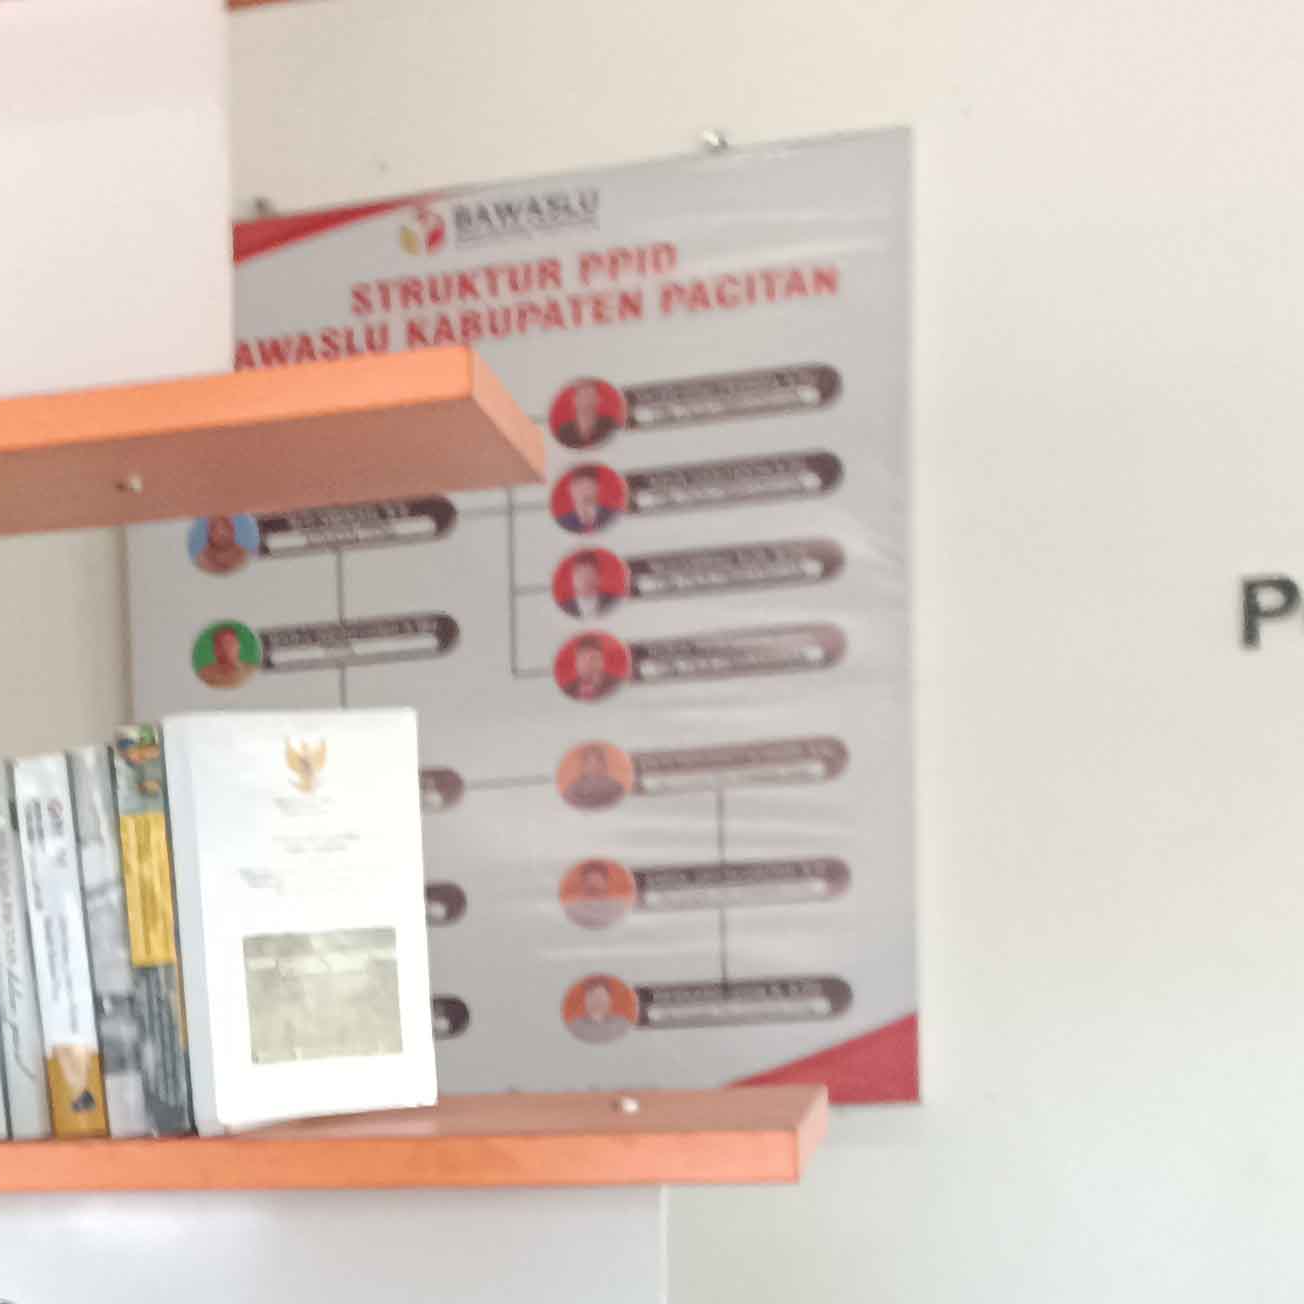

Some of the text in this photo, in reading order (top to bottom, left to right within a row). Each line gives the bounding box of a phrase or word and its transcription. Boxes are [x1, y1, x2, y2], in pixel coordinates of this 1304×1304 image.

[452, 187, 601, 230] BAWASLU
[350, 242, 678, 317] STRUKTUR PPID
[233, 265, 840, 373] AWASLU KABUPATEN PACITAN
